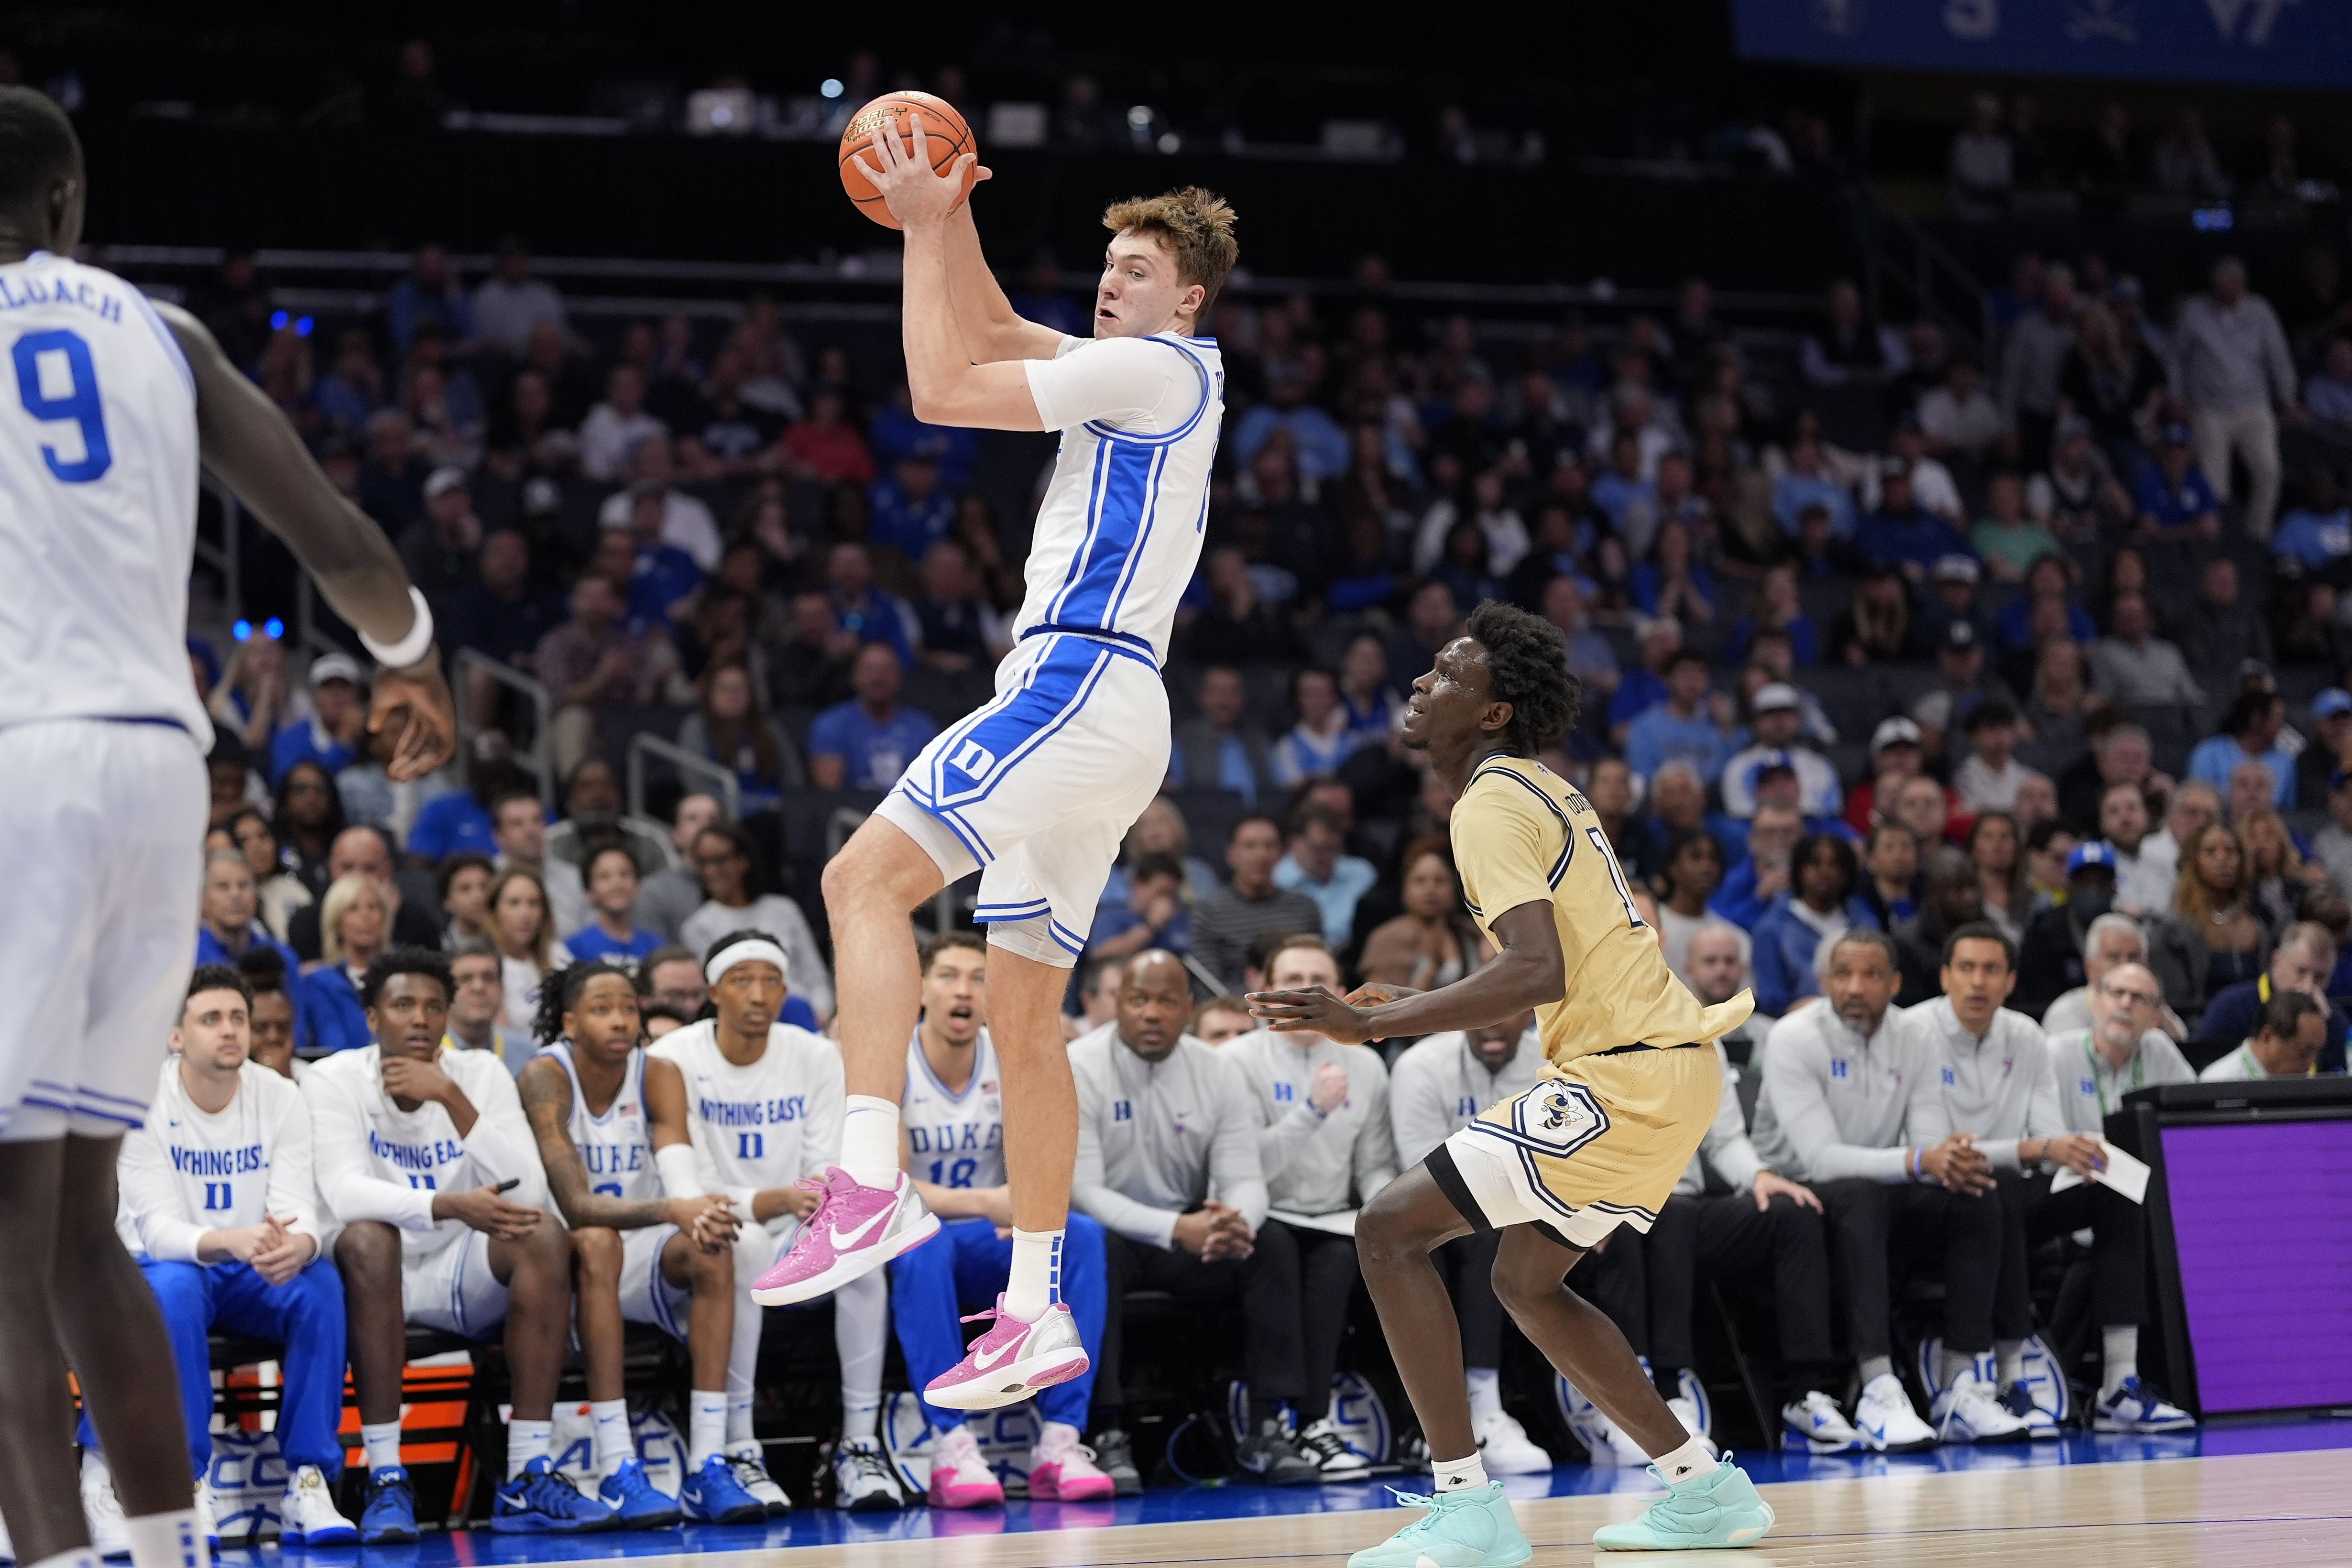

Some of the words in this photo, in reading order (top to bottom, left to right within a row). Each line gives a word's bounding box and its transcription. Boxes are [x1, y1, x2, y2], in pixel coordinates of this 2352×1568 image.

[12, 329, 111, 484] 9
[949, 739, 995, 781] D
[910, 1123, 1003, 1153] DUKE
